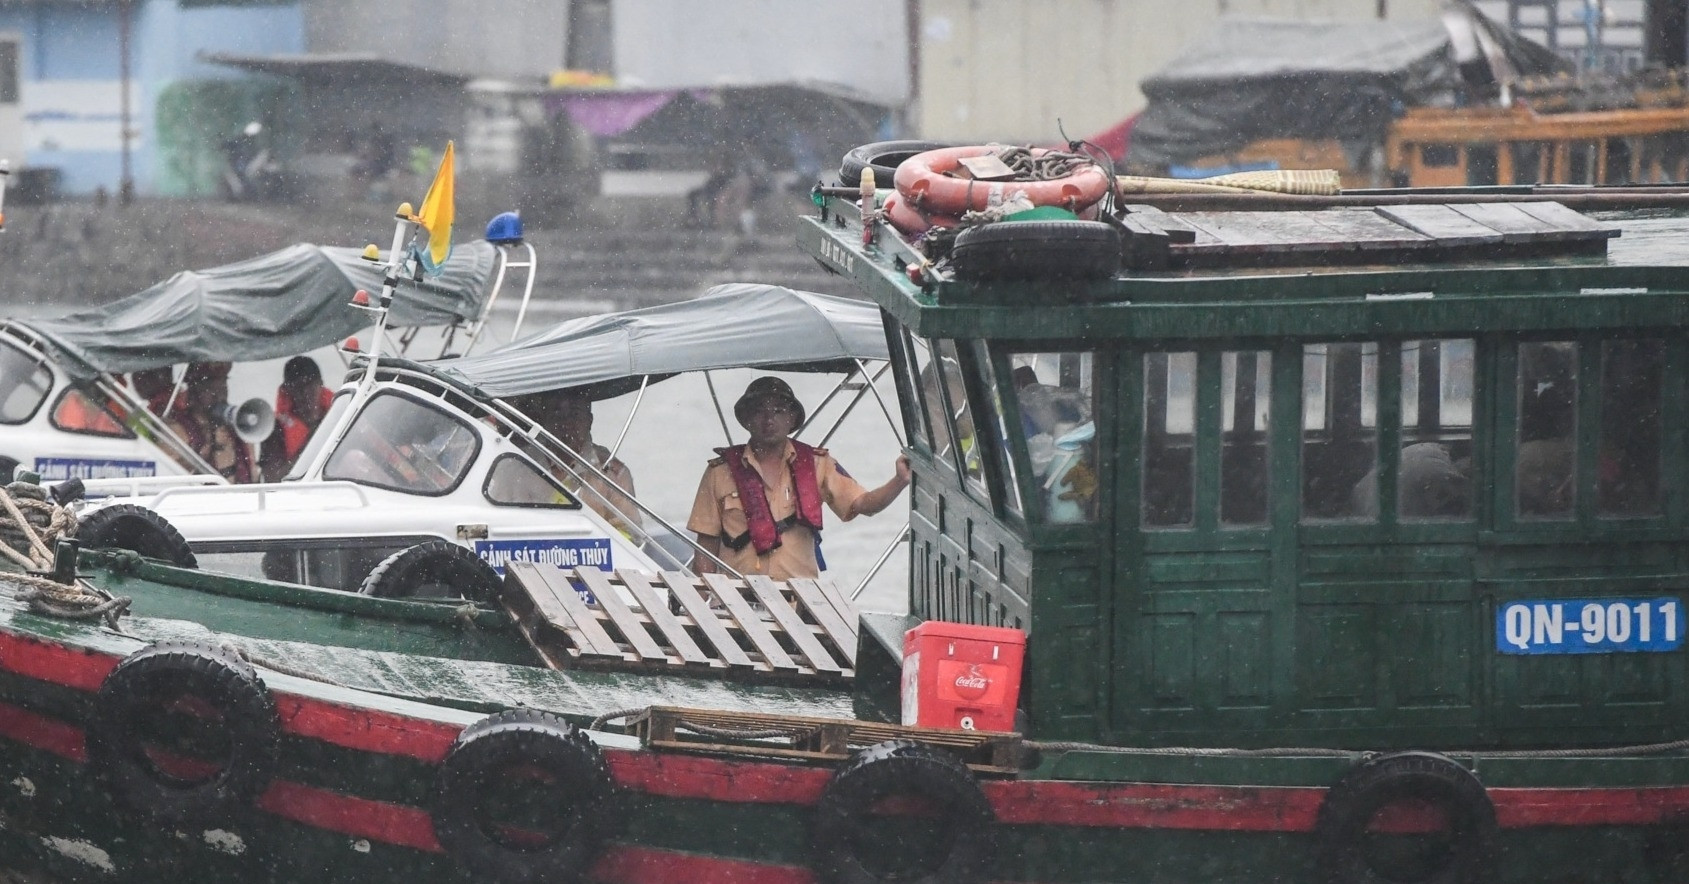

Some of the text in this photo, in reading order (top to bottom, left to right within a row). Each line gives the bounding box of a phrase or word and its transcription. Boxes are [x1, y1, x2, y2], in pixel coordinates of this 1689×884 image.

[480, 544, 511, 567] CẢNH
[514, 546, 536, 563] SÁT
[580, 541, 608, 565] THỦY
[1505, 602, 1676, 649] QN-9011
